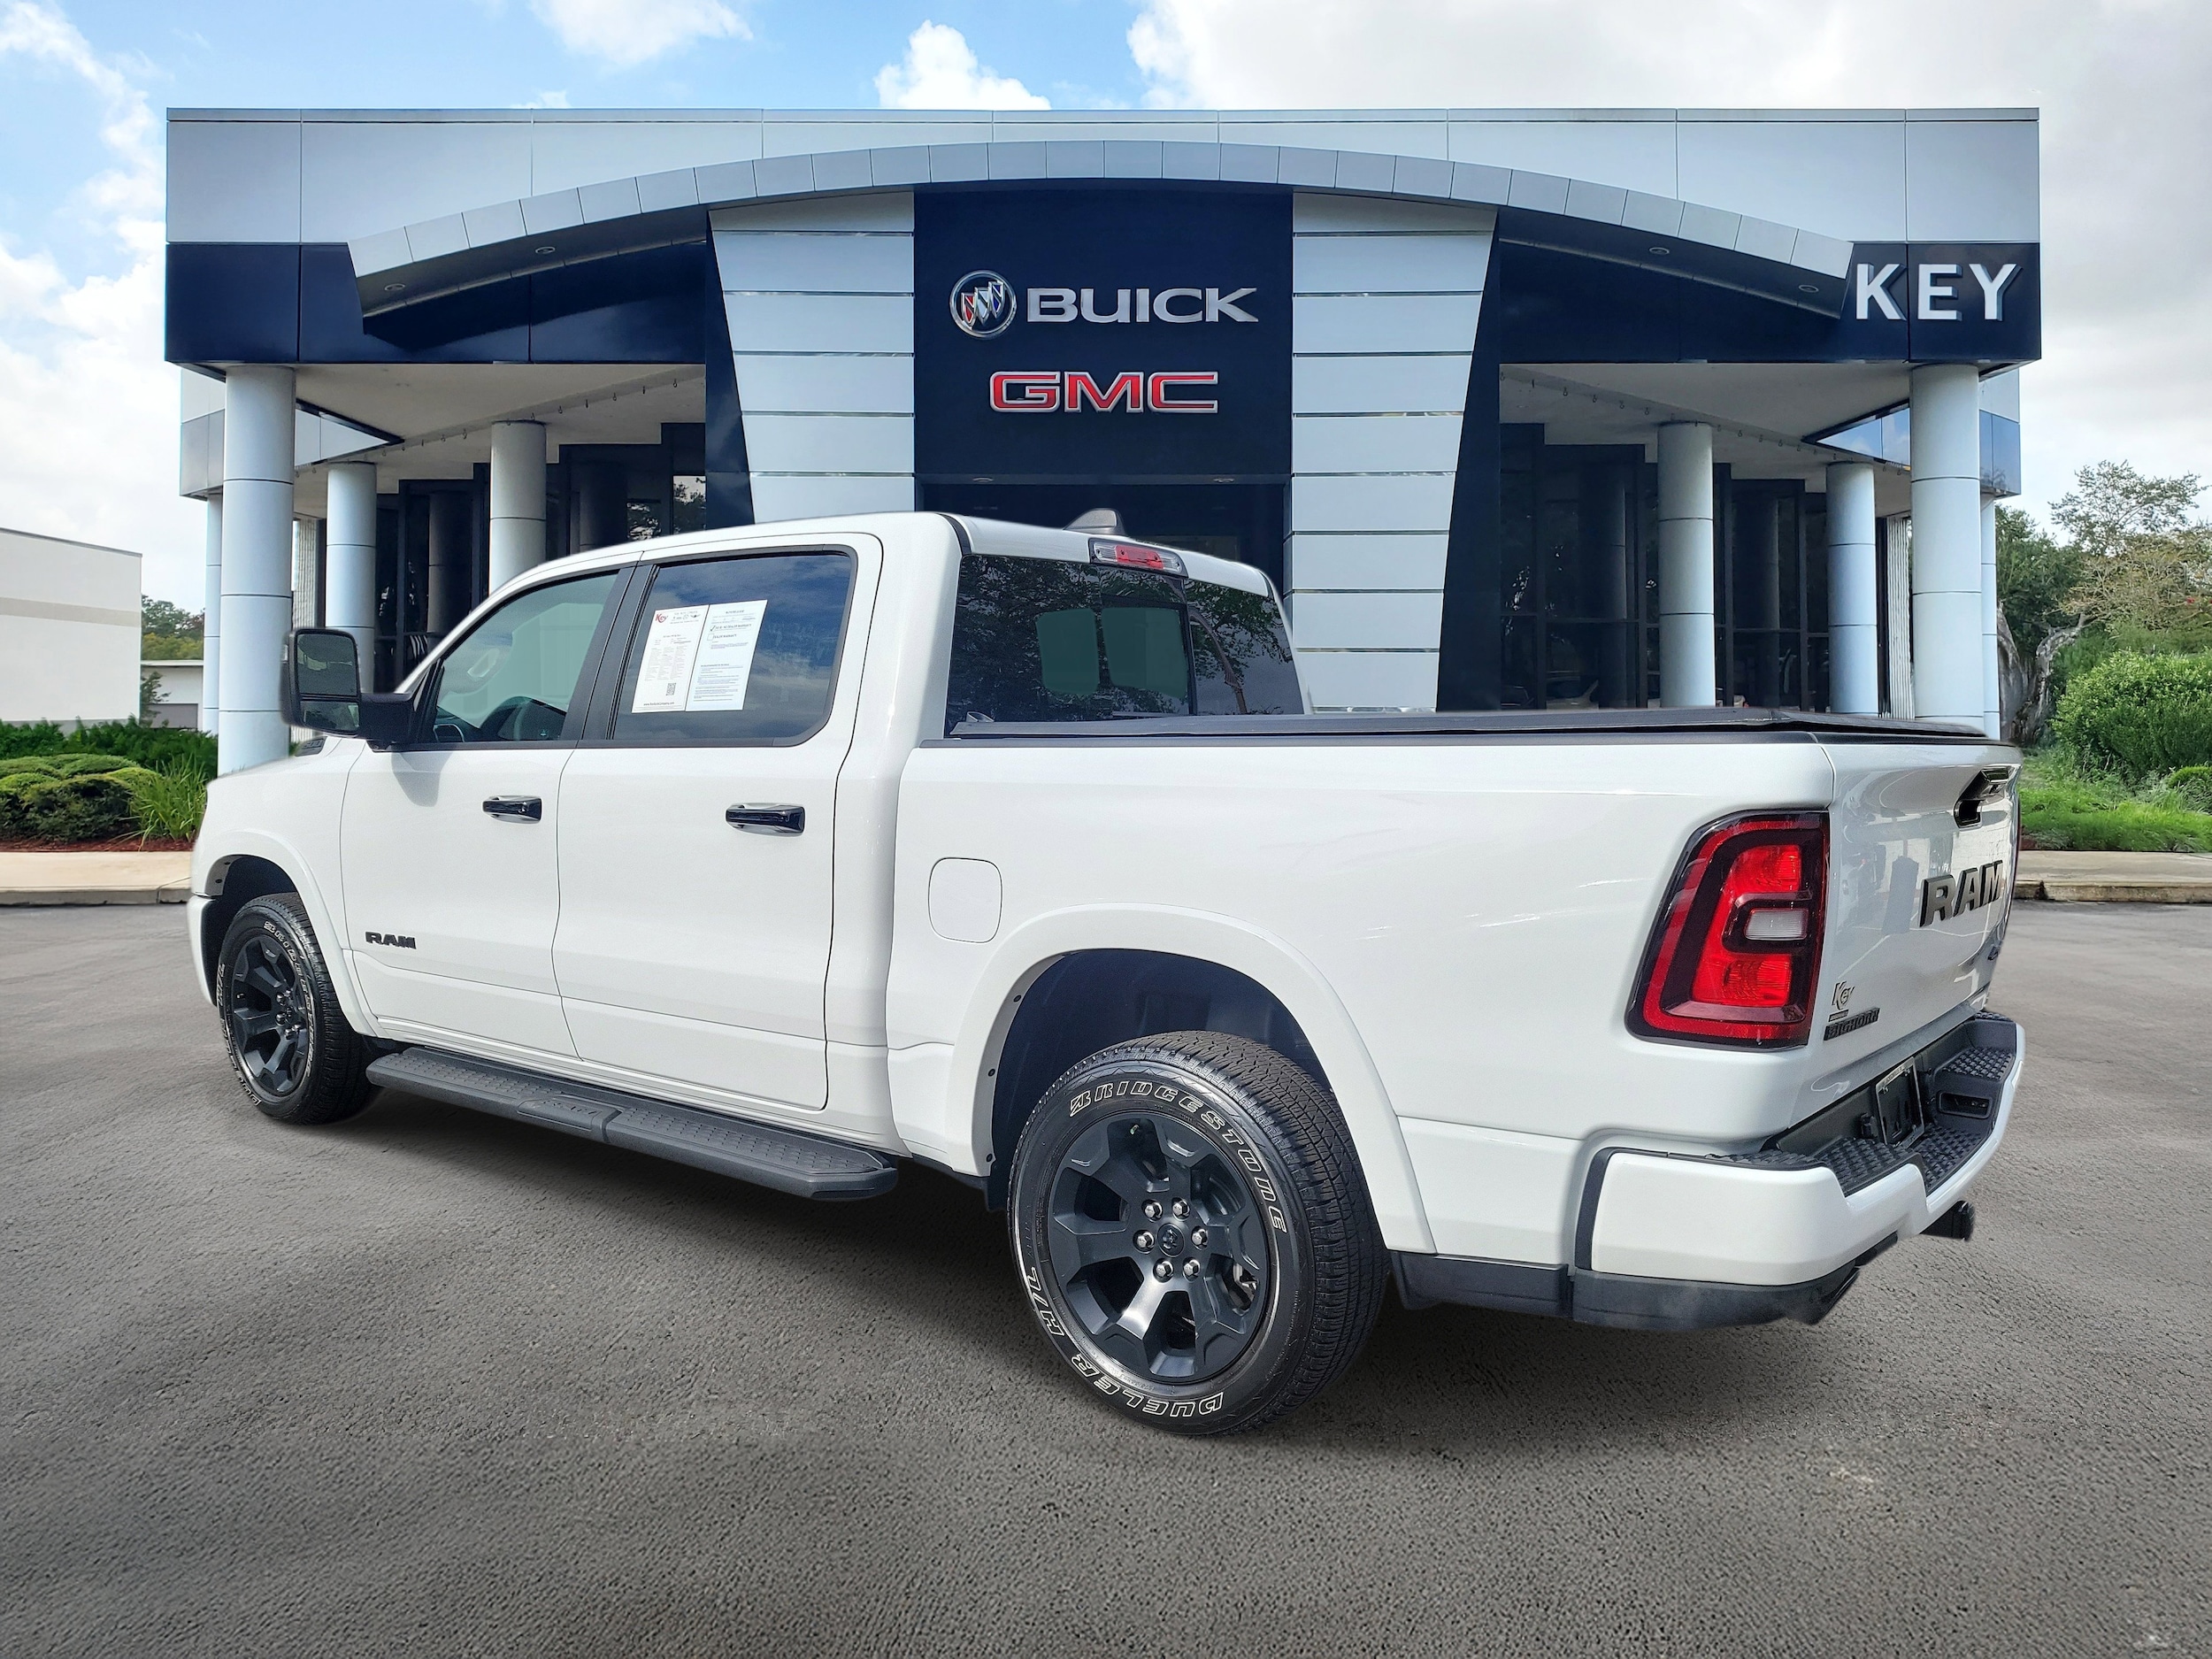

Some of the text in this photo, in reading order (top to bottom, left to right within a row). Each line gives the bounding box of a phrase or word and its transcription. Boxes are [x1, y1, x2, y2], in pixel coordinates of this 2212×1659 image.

[1026, 288, 1259, 323] BUICK
[1856, 263, 2023, 322] KEY
[989, 371, 1218, 413] GMC
[1919, 860, 2003, 927] RAM
[365, 931, 417, 949] RAM
[1070, 1080, 1286, 1234] BRIDGESTONE
[1071, 1352, 1224, 1417] DUELER
